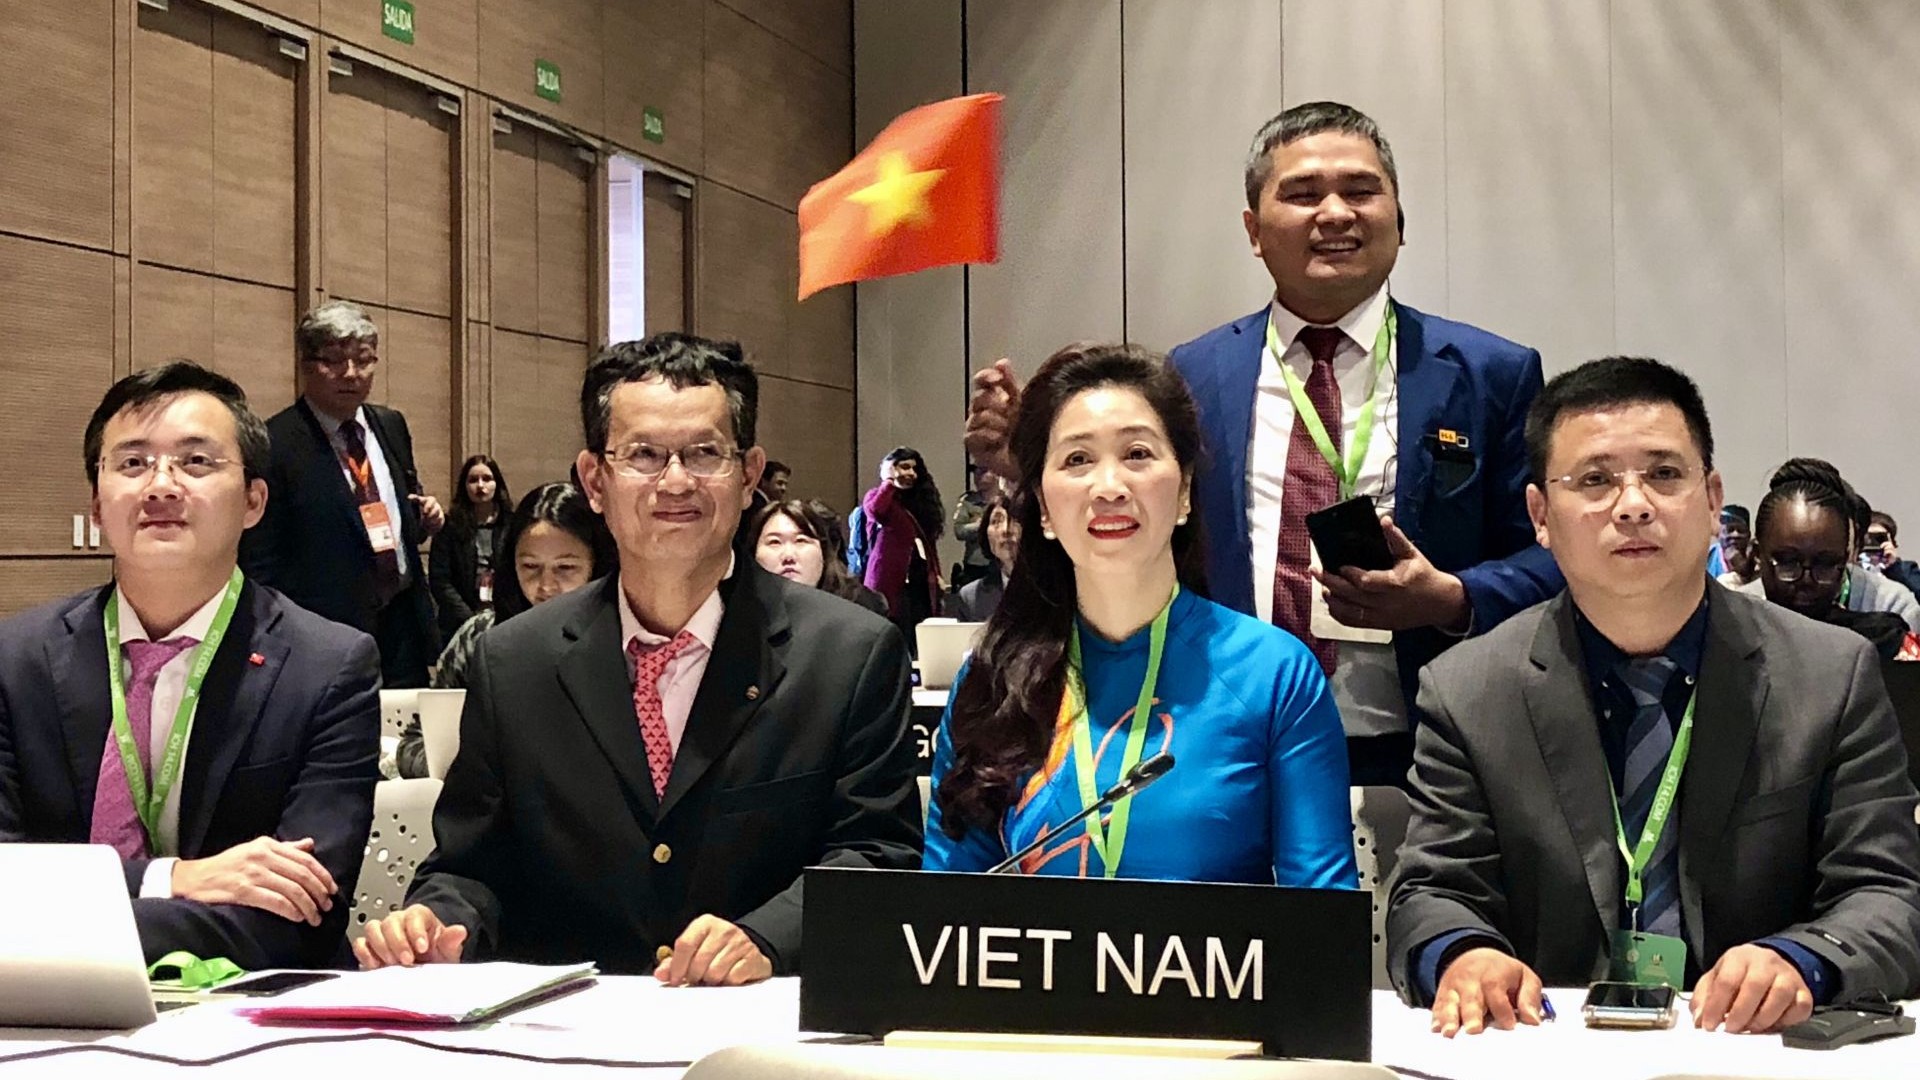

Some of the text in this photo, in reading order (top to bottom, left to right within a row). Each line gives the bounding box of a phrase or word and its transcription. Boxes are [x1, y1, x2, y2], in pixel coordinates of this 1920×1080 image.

[384, 2, 413, 33] SALIDA
[902, 923, 1264, 1001] VIET NAM
